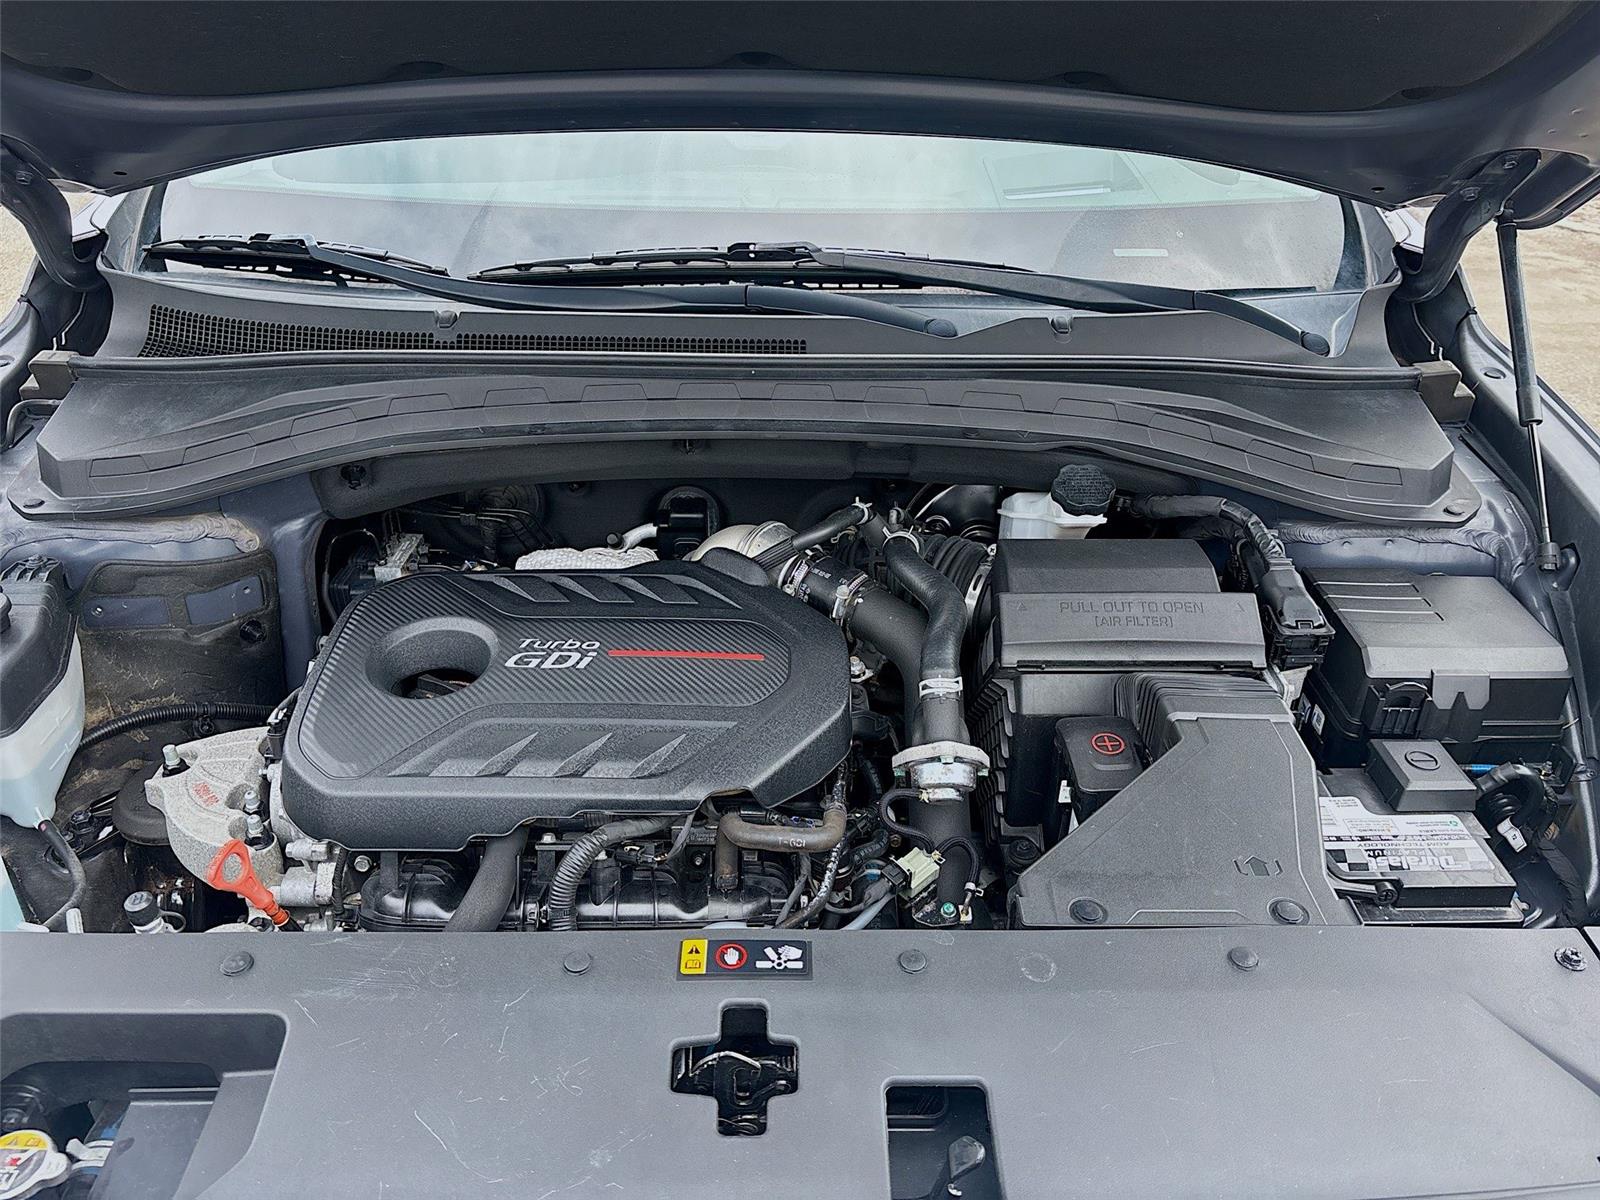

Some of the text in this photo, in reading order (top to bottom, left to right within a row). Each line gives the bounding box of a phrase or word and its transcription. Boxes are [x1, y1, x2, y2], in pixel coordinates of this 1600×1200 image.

[1059, 601, 1204, 614] PULL OUT TO OPEN
[519, 638, 601, 649] Turbo
[504, 651, 598, 669] GDi
[1366, 855, 1460, 870] Duralast
